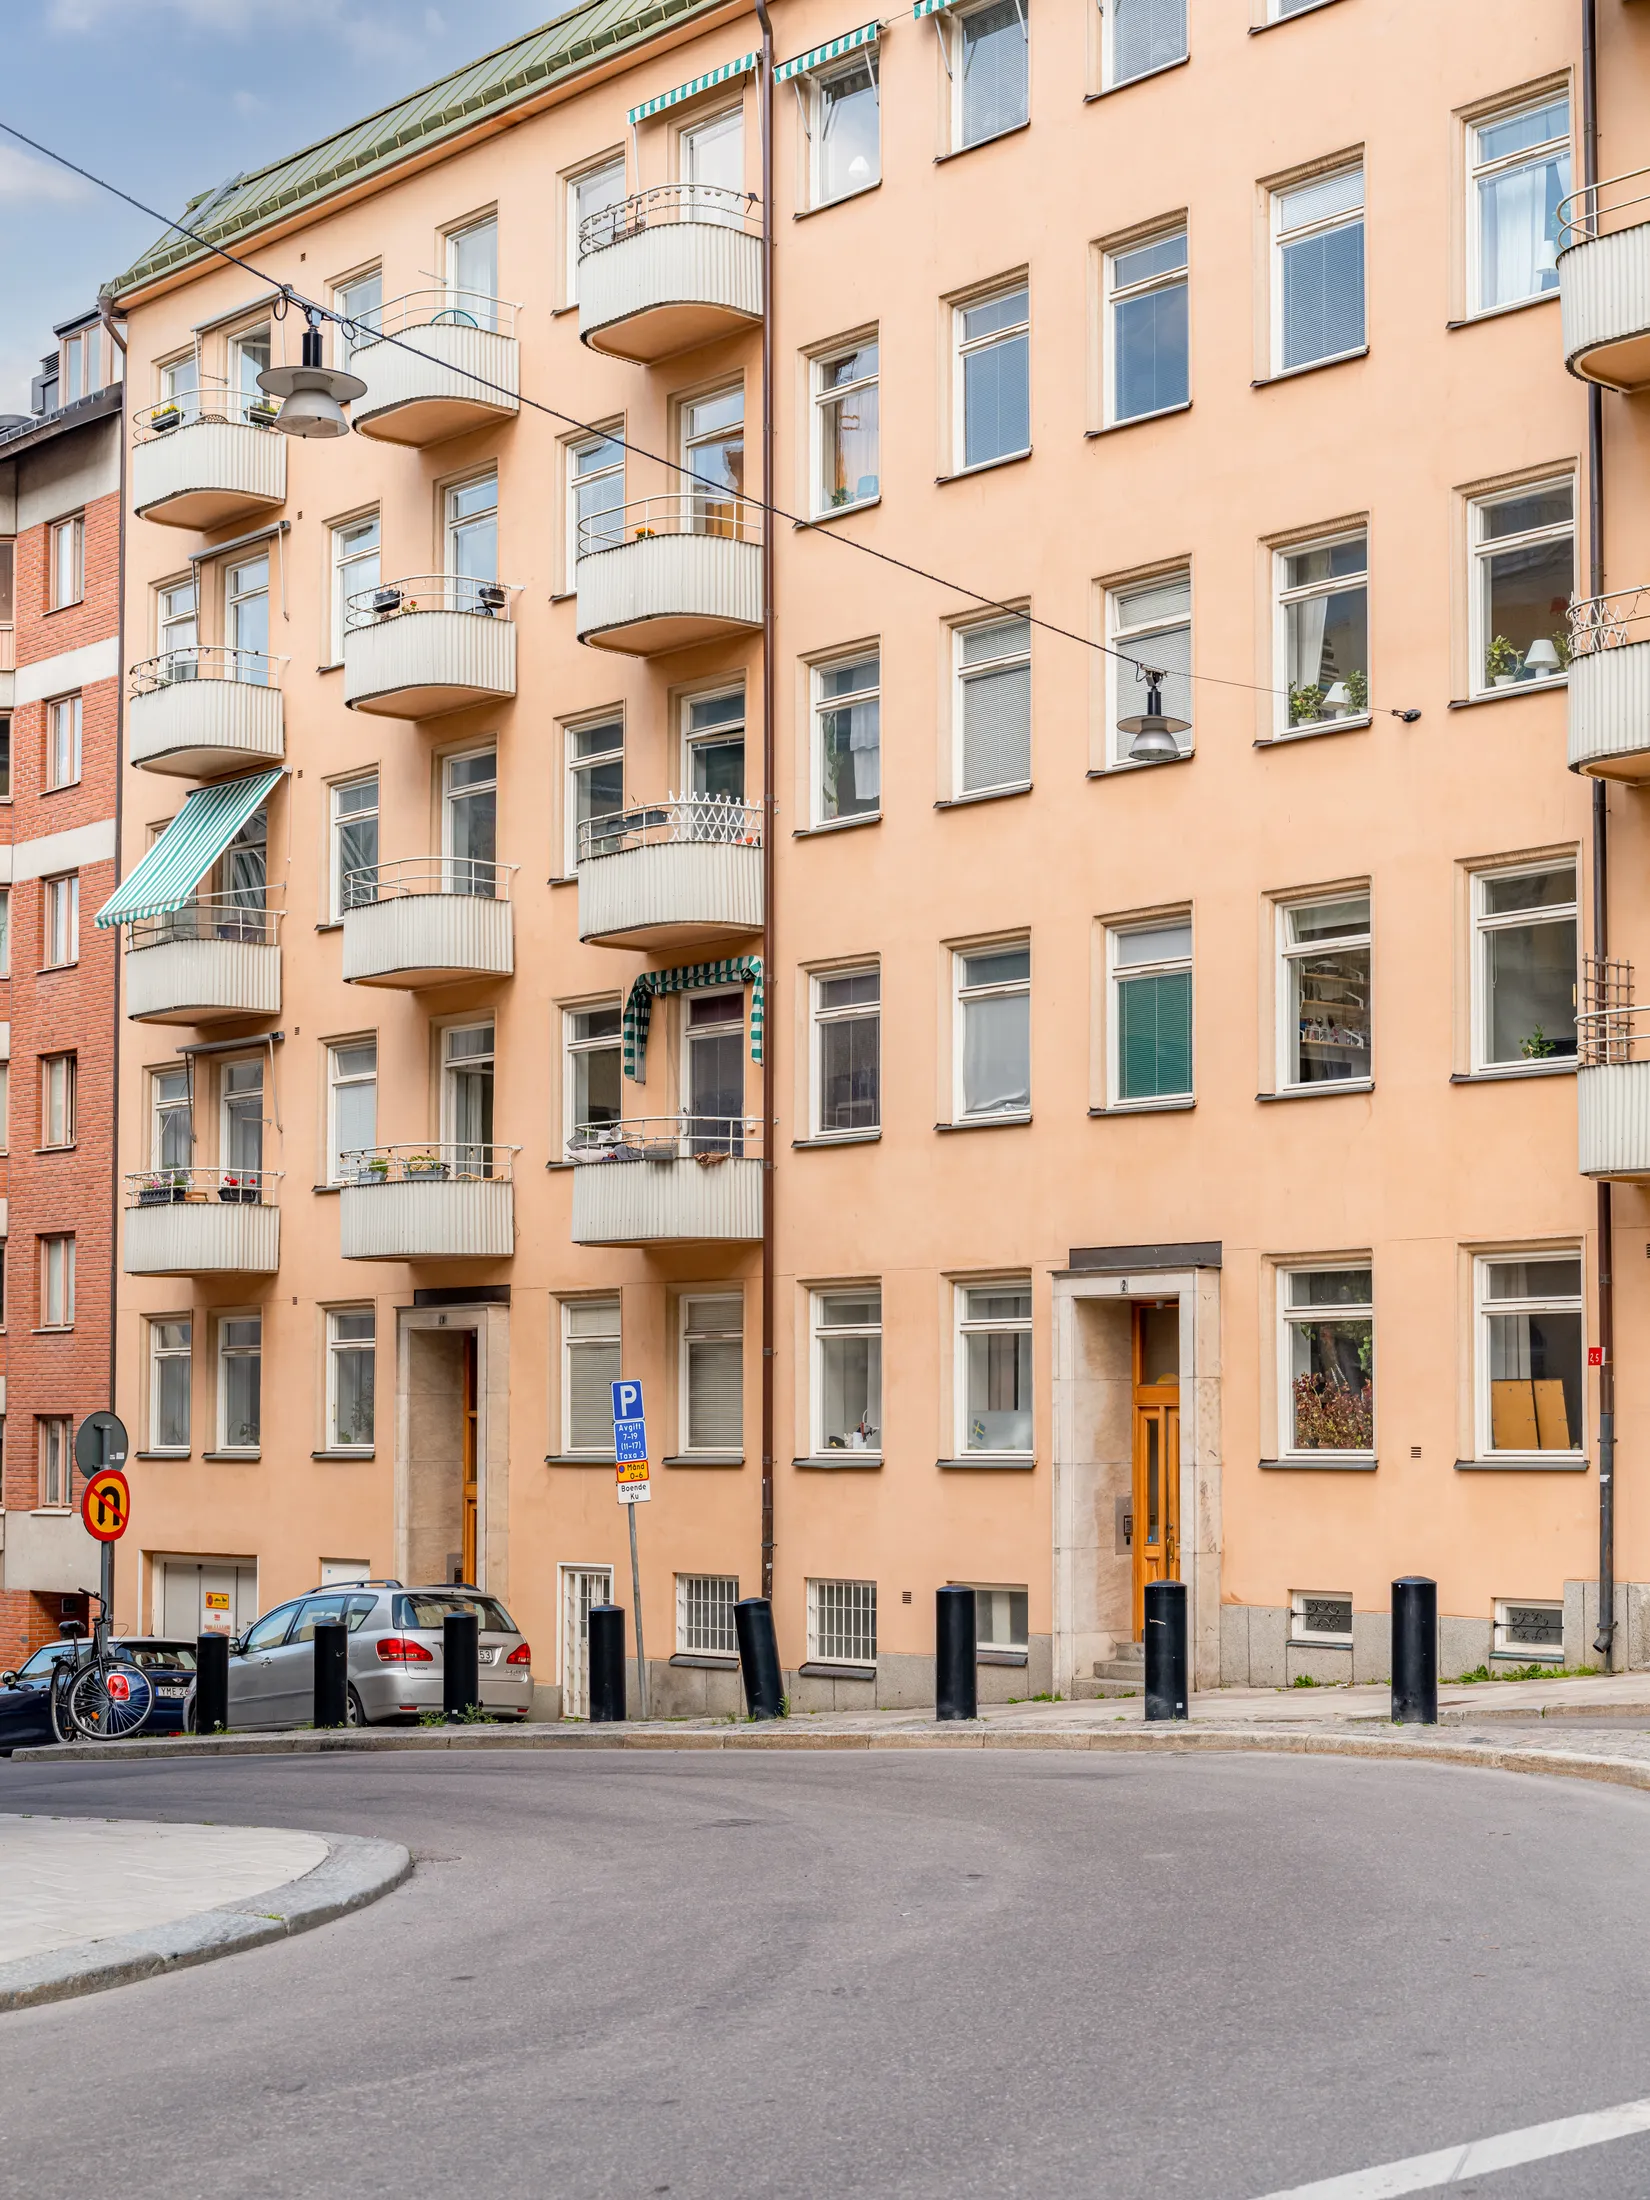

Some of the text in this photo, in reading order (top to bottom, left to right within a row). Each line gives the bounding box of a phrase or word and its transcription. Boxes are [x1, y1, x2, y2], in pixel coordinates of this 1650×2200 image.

[620, 1385, 637, 1416] P
[618, 1423, 641, 1432] Avgift
[622, 1432, 638, 1441] 7-19
[621, 1441, 641, 1451] (11-17)
[619, 1450, 645, 1460] Taxa 3
[627, 1463, 645, 1471] Månd
[630, 1472, 644, 1480] 0-6
[621, 1484, 647, 1493] Boende
[160, 1687, 177, 1696] YME
